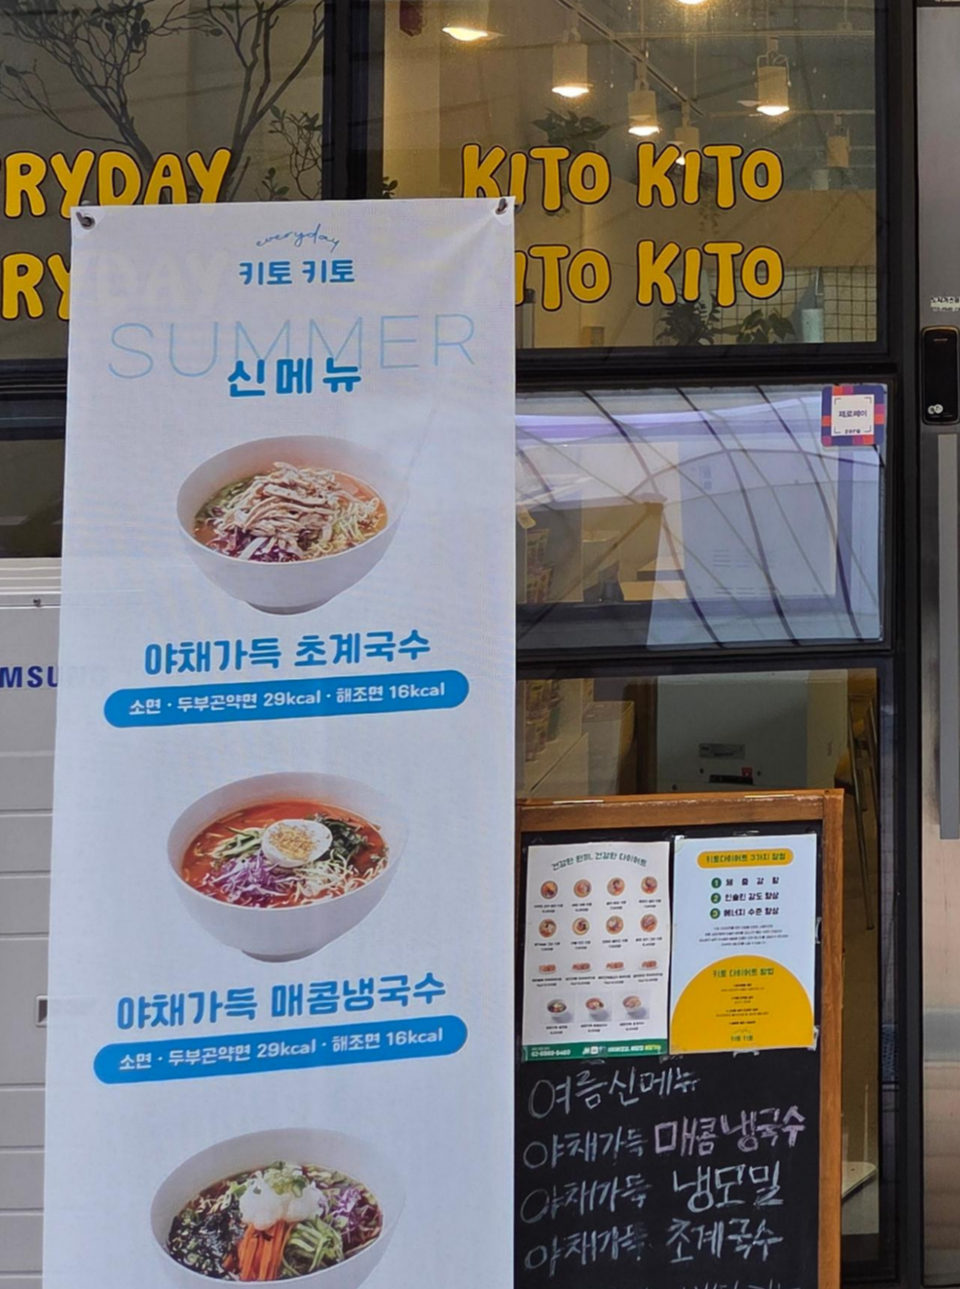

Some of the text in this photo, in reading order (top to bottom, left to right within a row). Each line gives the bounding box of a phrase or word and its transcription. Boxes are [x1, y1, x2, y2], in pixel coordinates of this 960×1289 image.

[462, 142, 612, 212] KITO
[637, 142, 784, 209] KITO
[256, 223, 340, 253] everyday
[239, 259, 355, 285] 키토 키토
[515, 244, 612, 312] ITO
[637, 239, 784, 307] KITO
[108, 313, 476, 379] SUMMER
[228, 357, 361, 397] 신메뉴
[145, 629, 431, 675] 야채가득 초계국수
[129, 681, 445, 715] 소면 두부곤약면 29kcal 해조면 16kcal
[117, 972, 446, 1031] 야채가득 매콤냉국수
[119, 1027, 443, 1071] 소면 두부곤약면 29kcal 해조면 16kcal
[673, 1161, 784, 1212] 냉모밀
[666, 1218, 784, 1263] 초계국수
